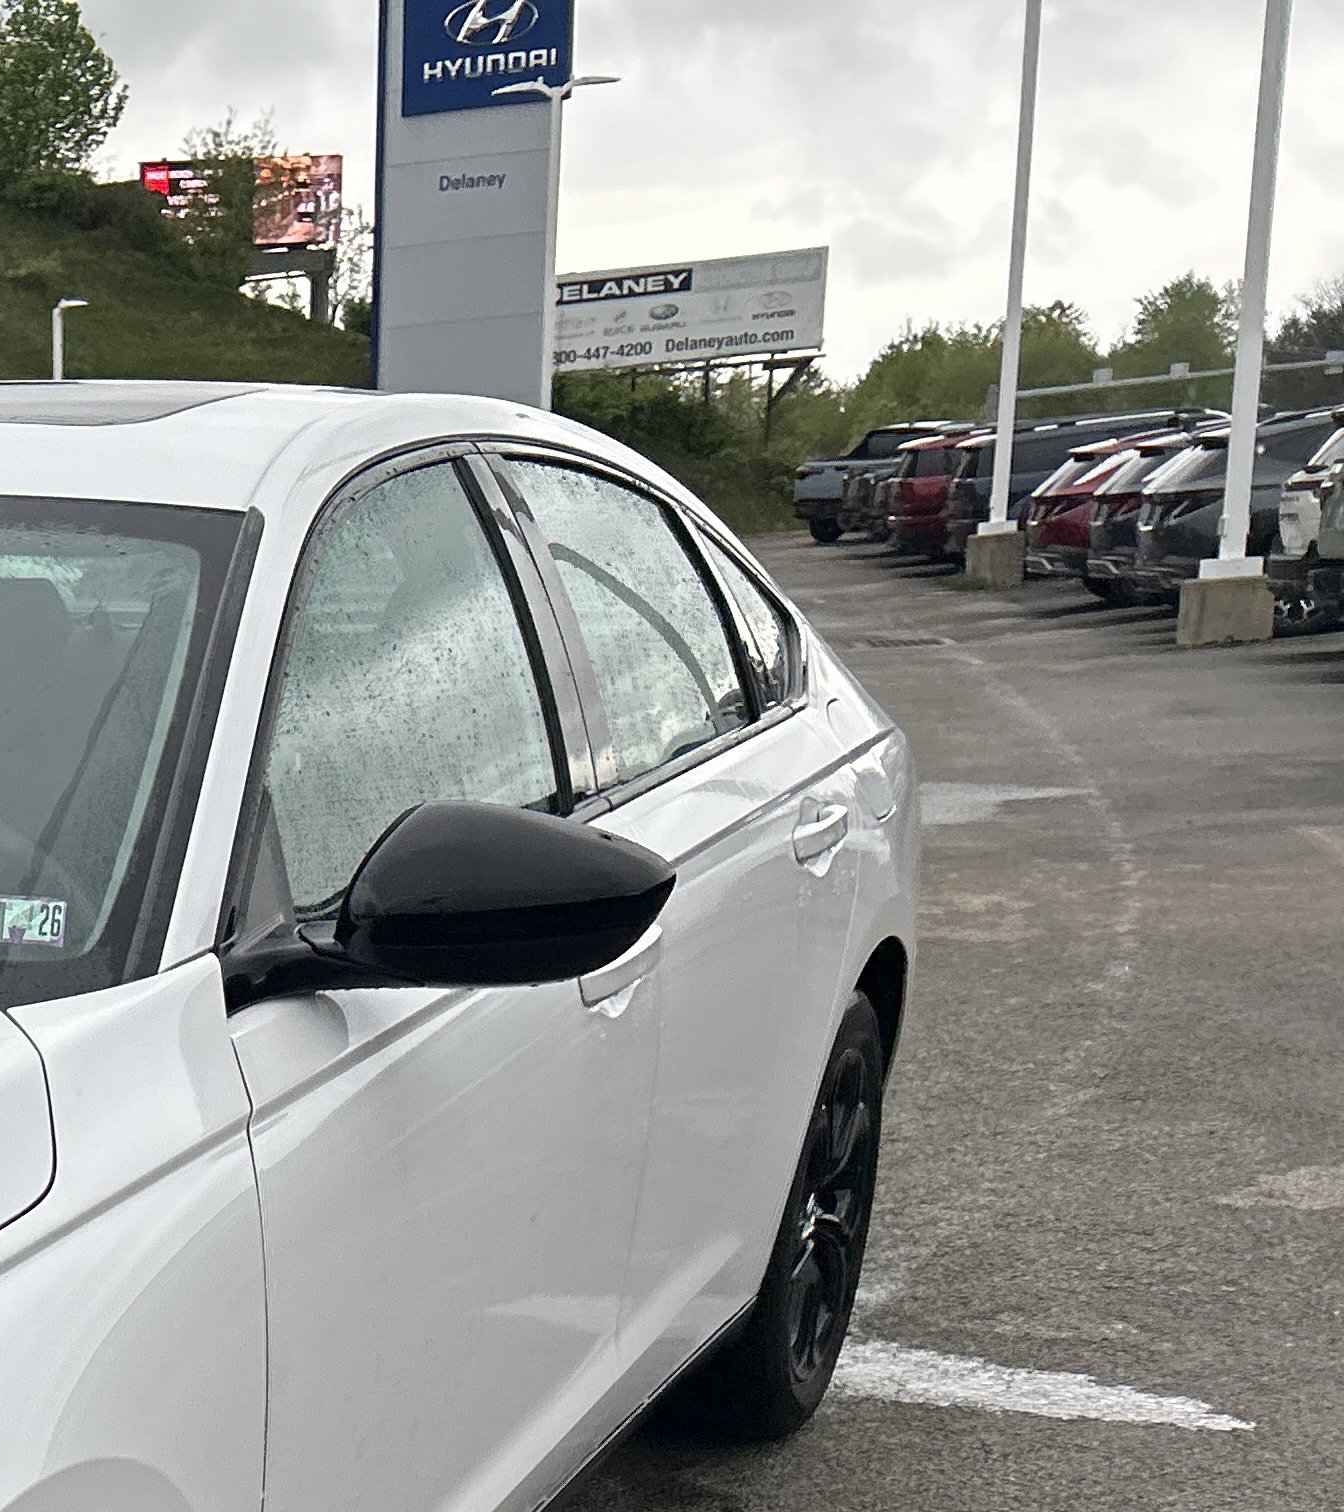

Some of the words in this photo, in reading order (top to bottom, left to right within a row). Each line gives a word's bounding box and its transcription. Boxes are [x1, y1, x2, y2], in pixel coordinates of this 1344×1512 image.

[422, 47, 558, 83] HYUNDAI
[438, 173, 507, 193] Delaney
[664, 329, 795, 353] Delaneyauto.com
[37, 903, 62, 937] 26
